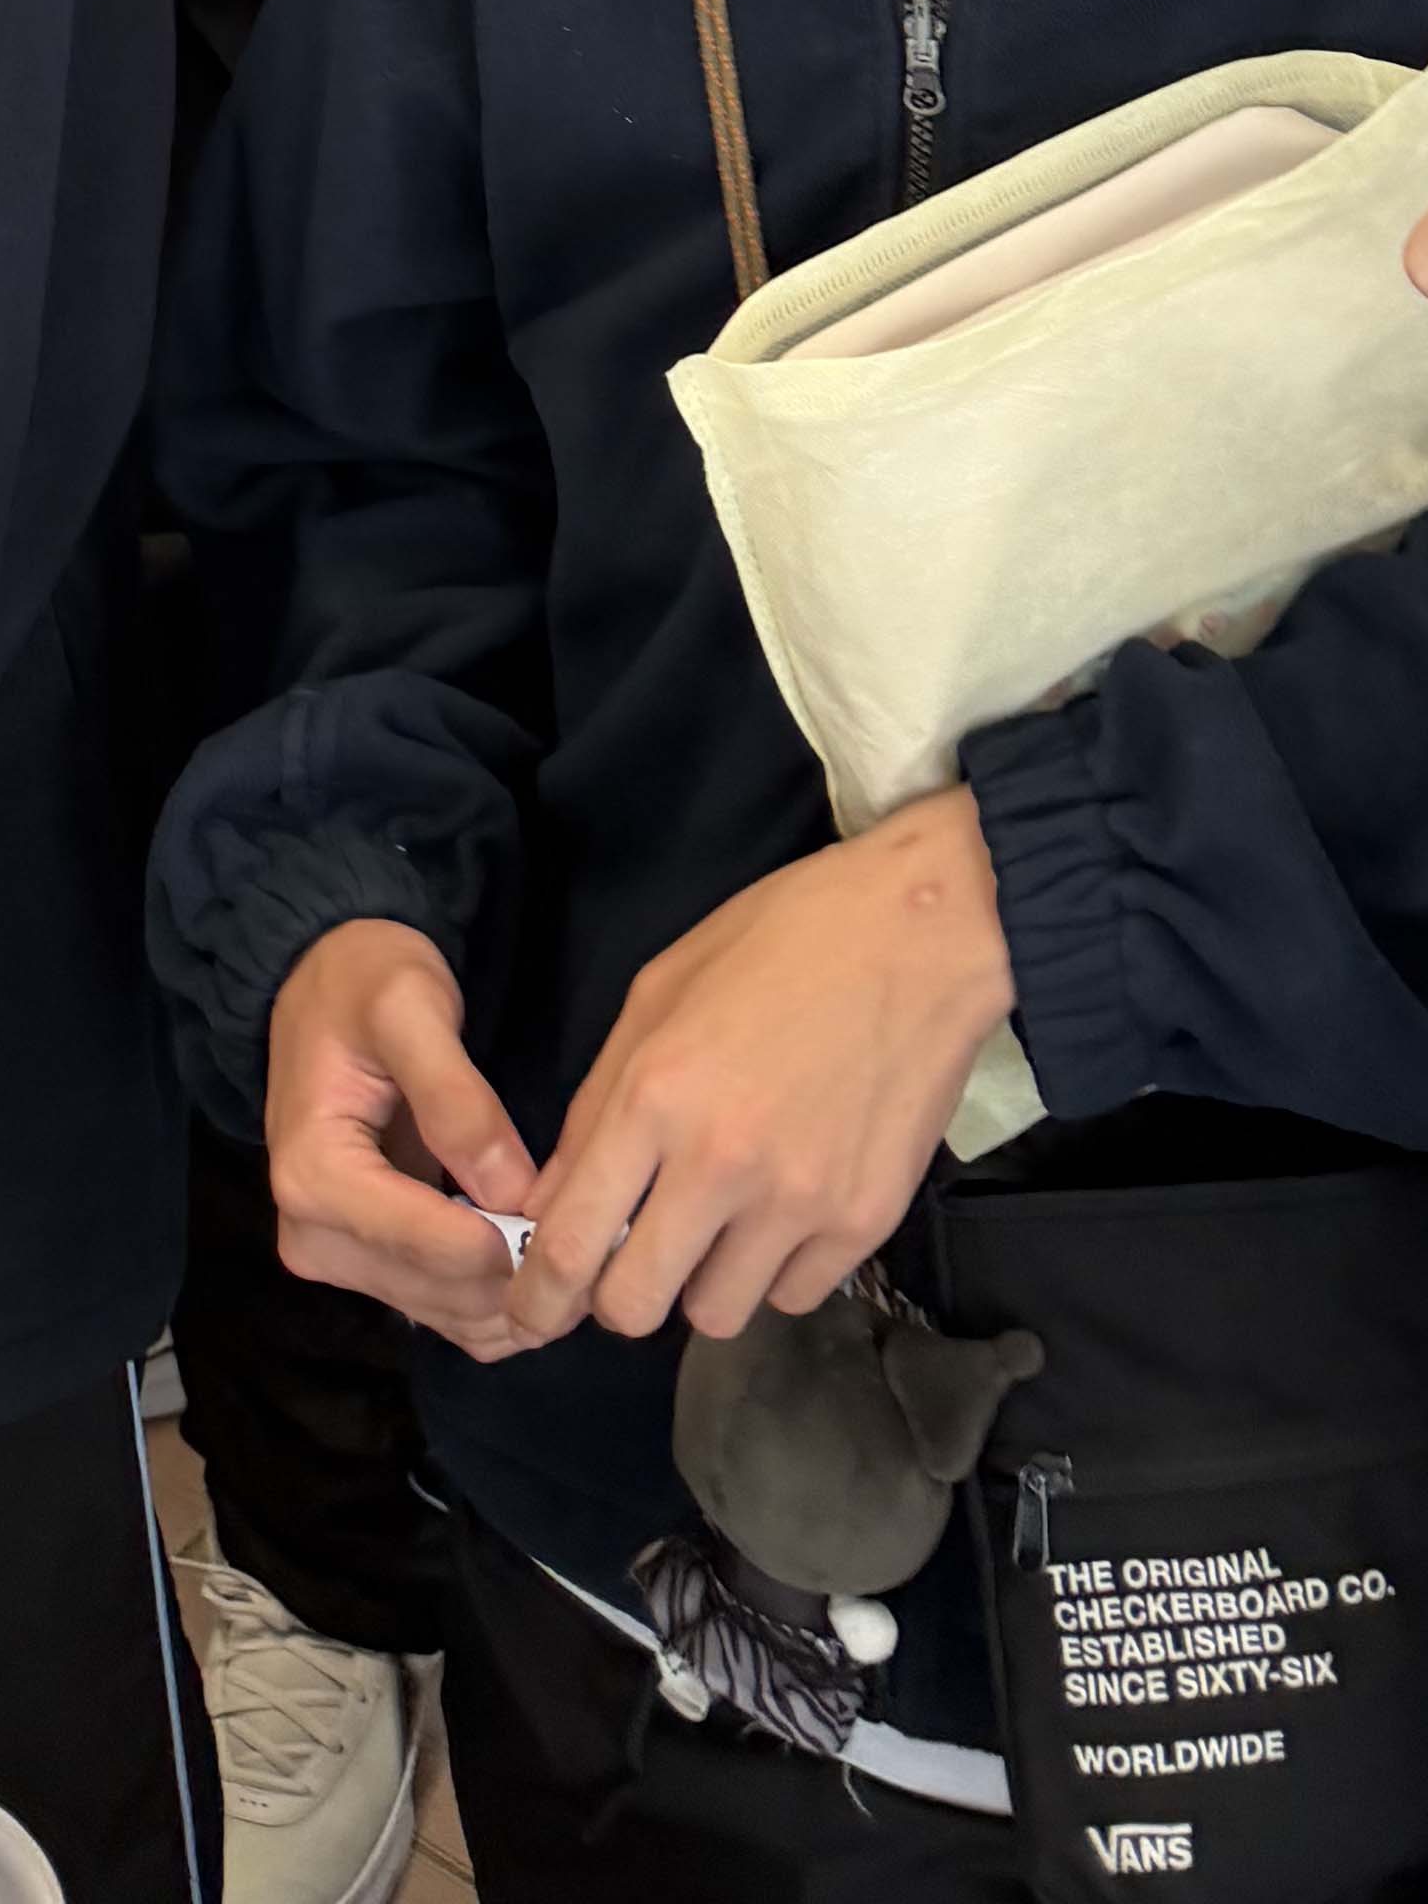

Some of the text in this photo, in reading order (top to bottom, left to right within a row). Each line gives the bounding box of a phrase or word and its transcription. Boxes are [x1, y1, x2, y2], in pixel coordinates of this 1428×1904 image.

[1044, 1547, 1282, 1596] THE ORIGINAL
[1053, 1569, 1396, 1633] CHECKERBOARD CO.
[1060, 1623, 1287, 1668] ESTABLISHED
[1064, 1652, 1339, 1707] SINCE SIXTY-SIX
[1073, 1730, 1285, 1776] WORLDWIDE
[1085, 1822, 1194, 1875] VANS
